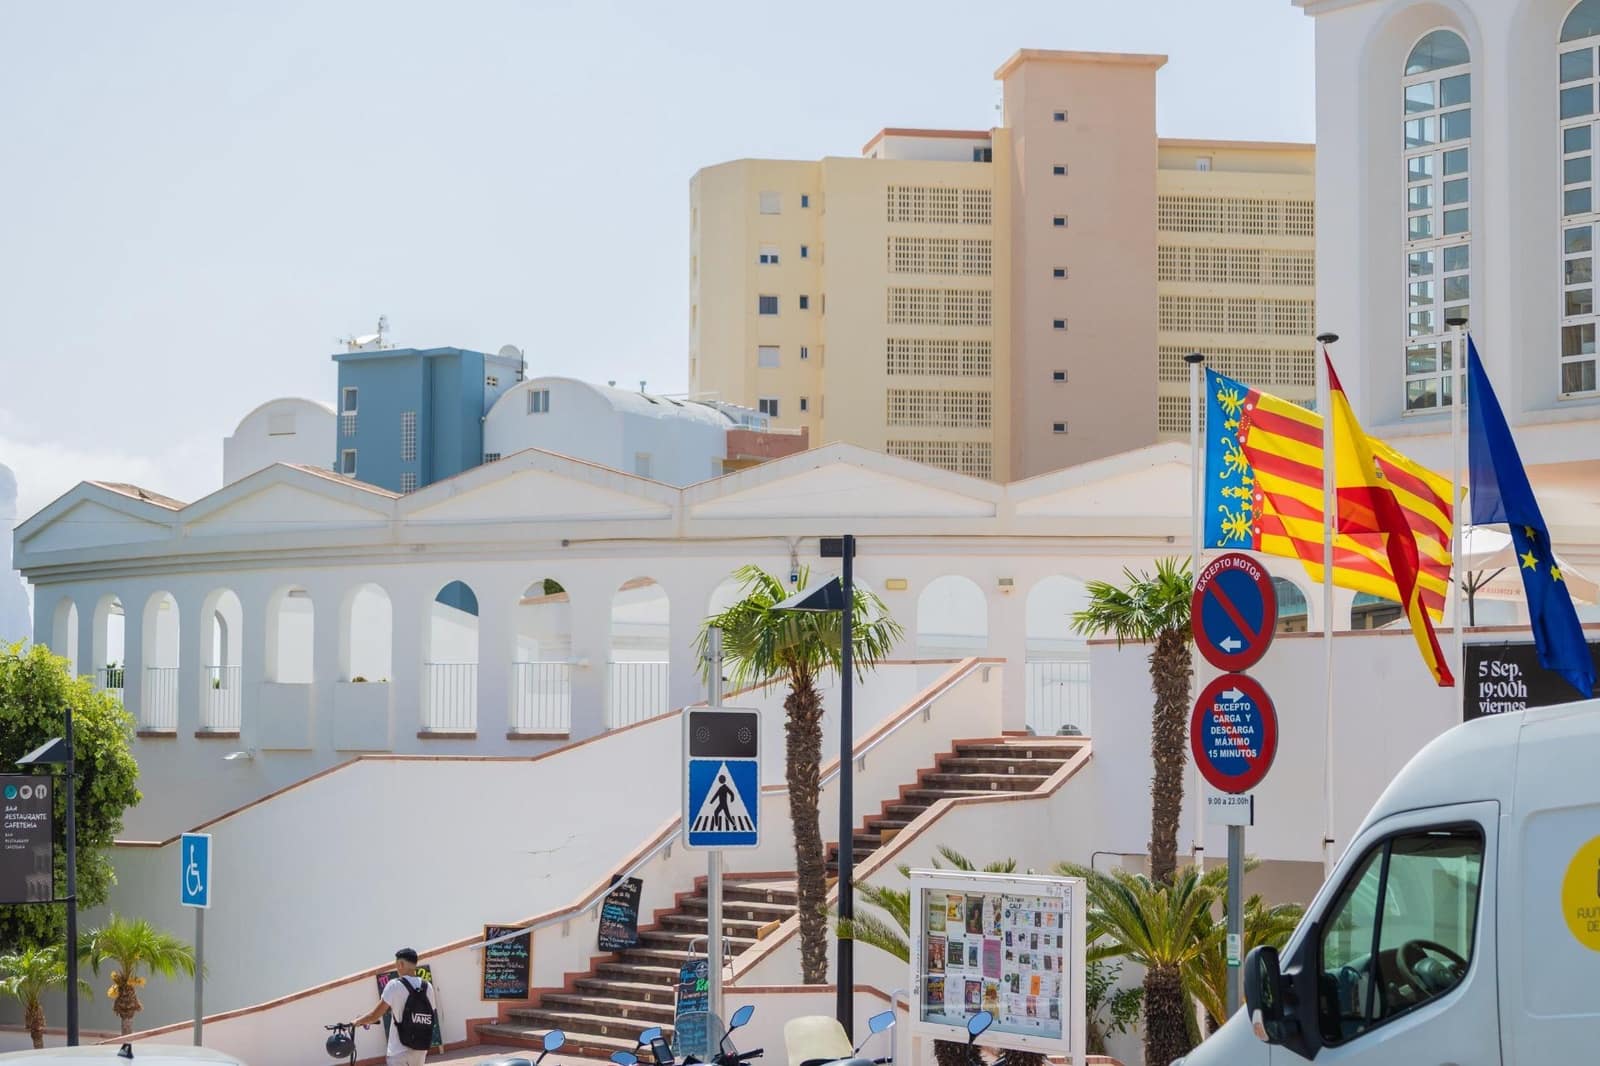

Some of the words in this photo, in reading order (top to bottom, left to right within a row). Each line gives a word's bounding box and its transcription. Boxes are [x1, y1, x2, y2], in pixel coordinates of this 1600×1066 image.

[1197, 558, 1231, 592] EXCEPTO
[1232, 558, 1261, 581] MOTOS
[1479, 660, 1488, 677] 5
[1491, 660, 1522, 682] Sep.
[1479, 680, 1528, 698] 19:00h
[1213, 703, 1251, 712] EXCEPTO
[1479, 699, 1526, 713] viernes
[1213, 714, 1241, 723] CARGA
[1245, 714, 1251, 722] Y
[1210, 725, 1254, 735] DESCARGA
[1208, 749, 1218, 758] 15
[1219, 749, 1257, 758] MINUTOS
[411, 1012, 432, 1025] VANS
